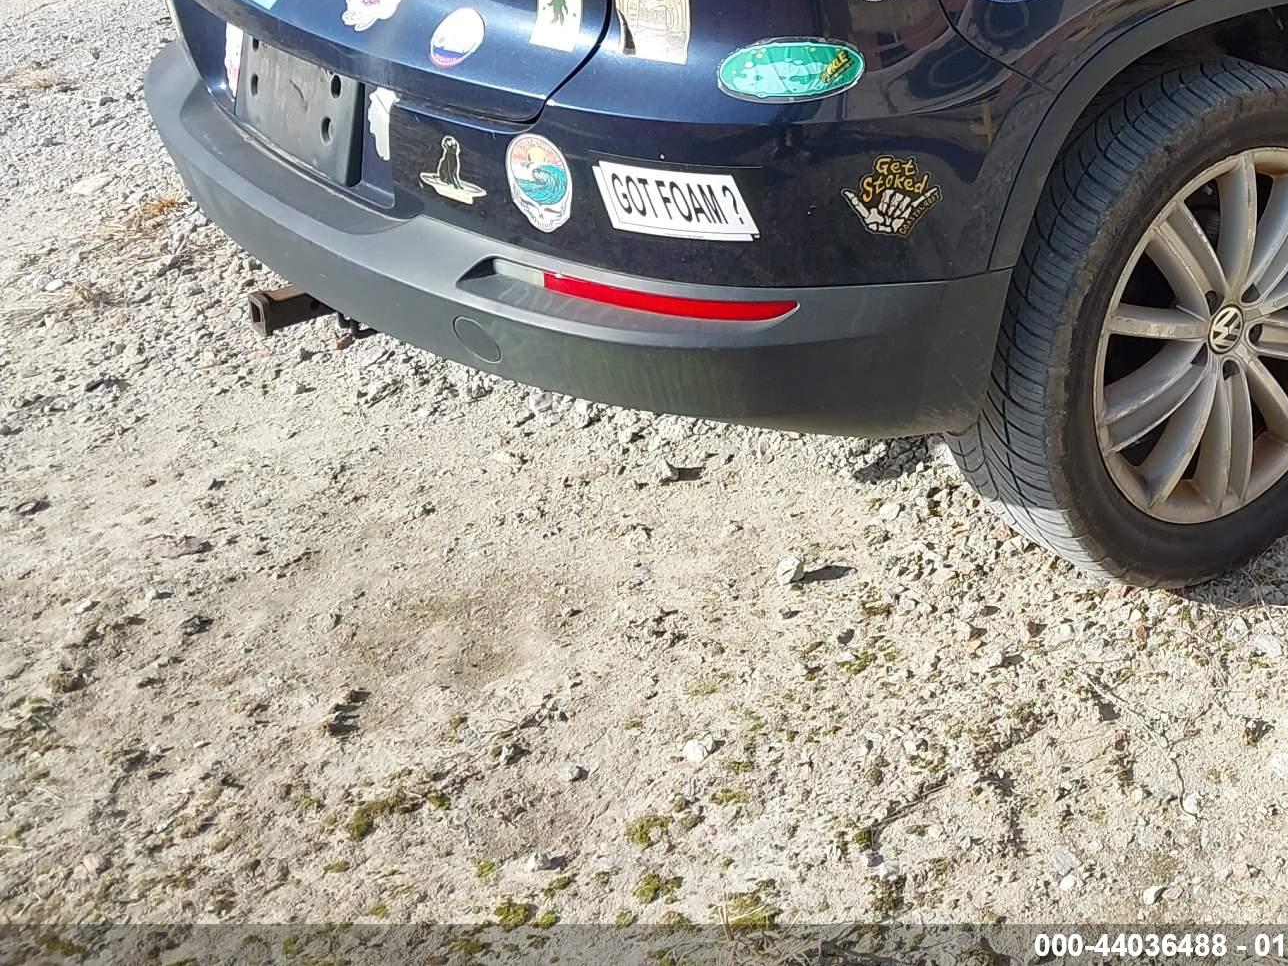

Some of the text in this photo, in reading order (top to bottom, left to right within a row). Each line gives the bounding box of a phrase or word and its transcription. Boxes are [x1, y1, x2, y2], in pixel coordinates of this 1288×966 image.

[876, 158, 916, 175] Get
[612, 173, 658, 218] GOT
[655, 180, 728, 224] FOAM
[863, 173, 928, 202] Stoked
